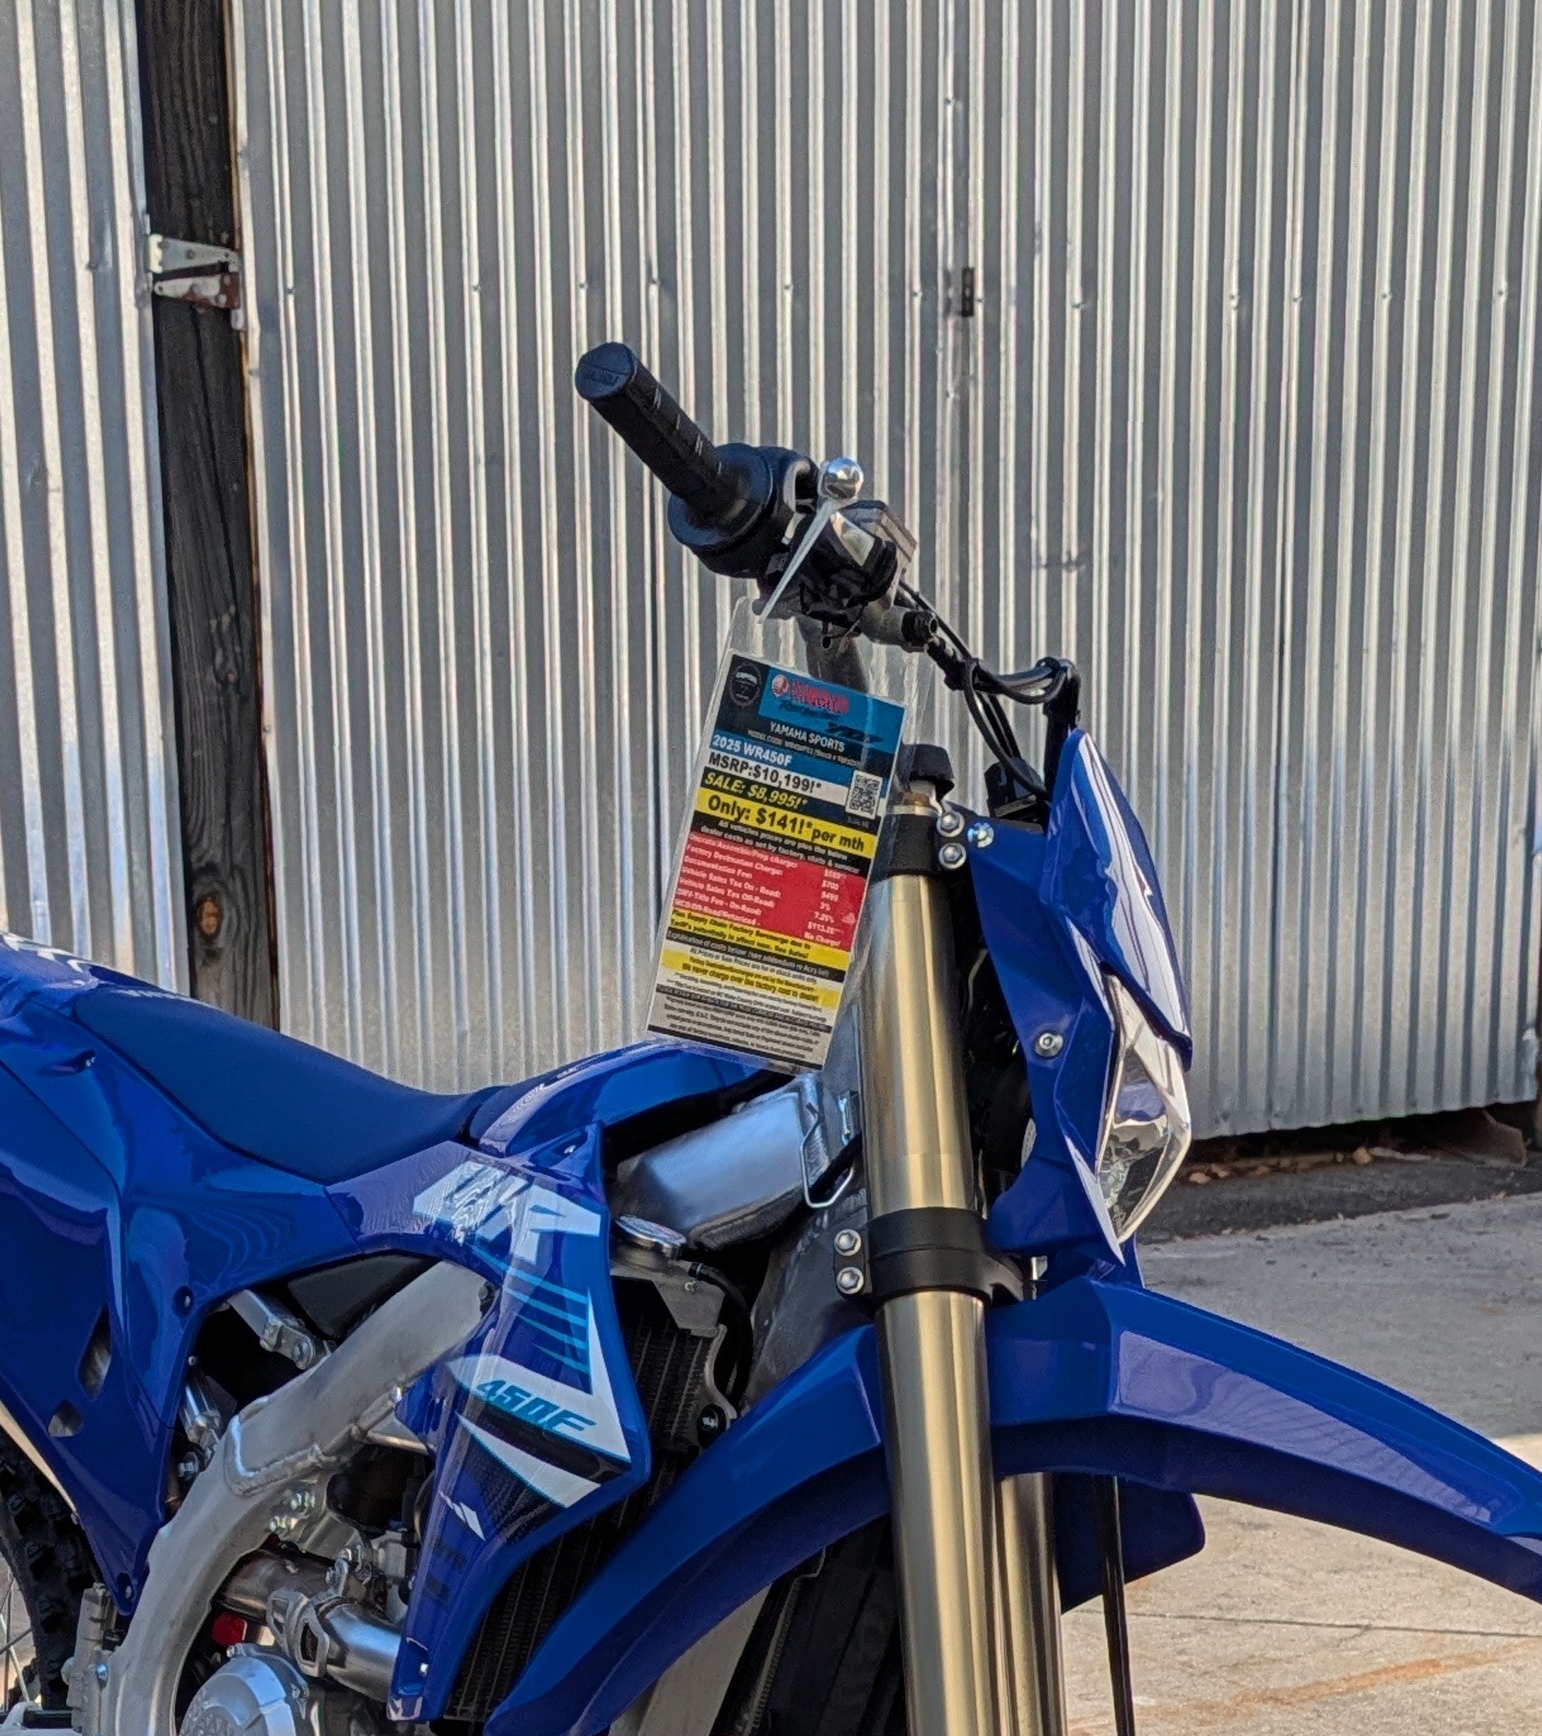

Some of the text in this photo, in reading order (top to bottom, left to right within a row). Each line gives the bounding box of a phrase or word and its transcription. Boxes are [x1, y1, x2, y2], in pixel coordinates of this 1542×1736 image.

[711, 733, 793, 767] 2025 WR450F
[769, 721, 808, 741] YAMAHA
[808, 732, 845, 752] SPORTS
[704, 770, 746, 794] SALE:
[705, 793, 752, 824] Only:
[810, 826, 836, 847] per
[838, 833, 865, 852] mth
[477, 1379, 596, 1433] 450F
